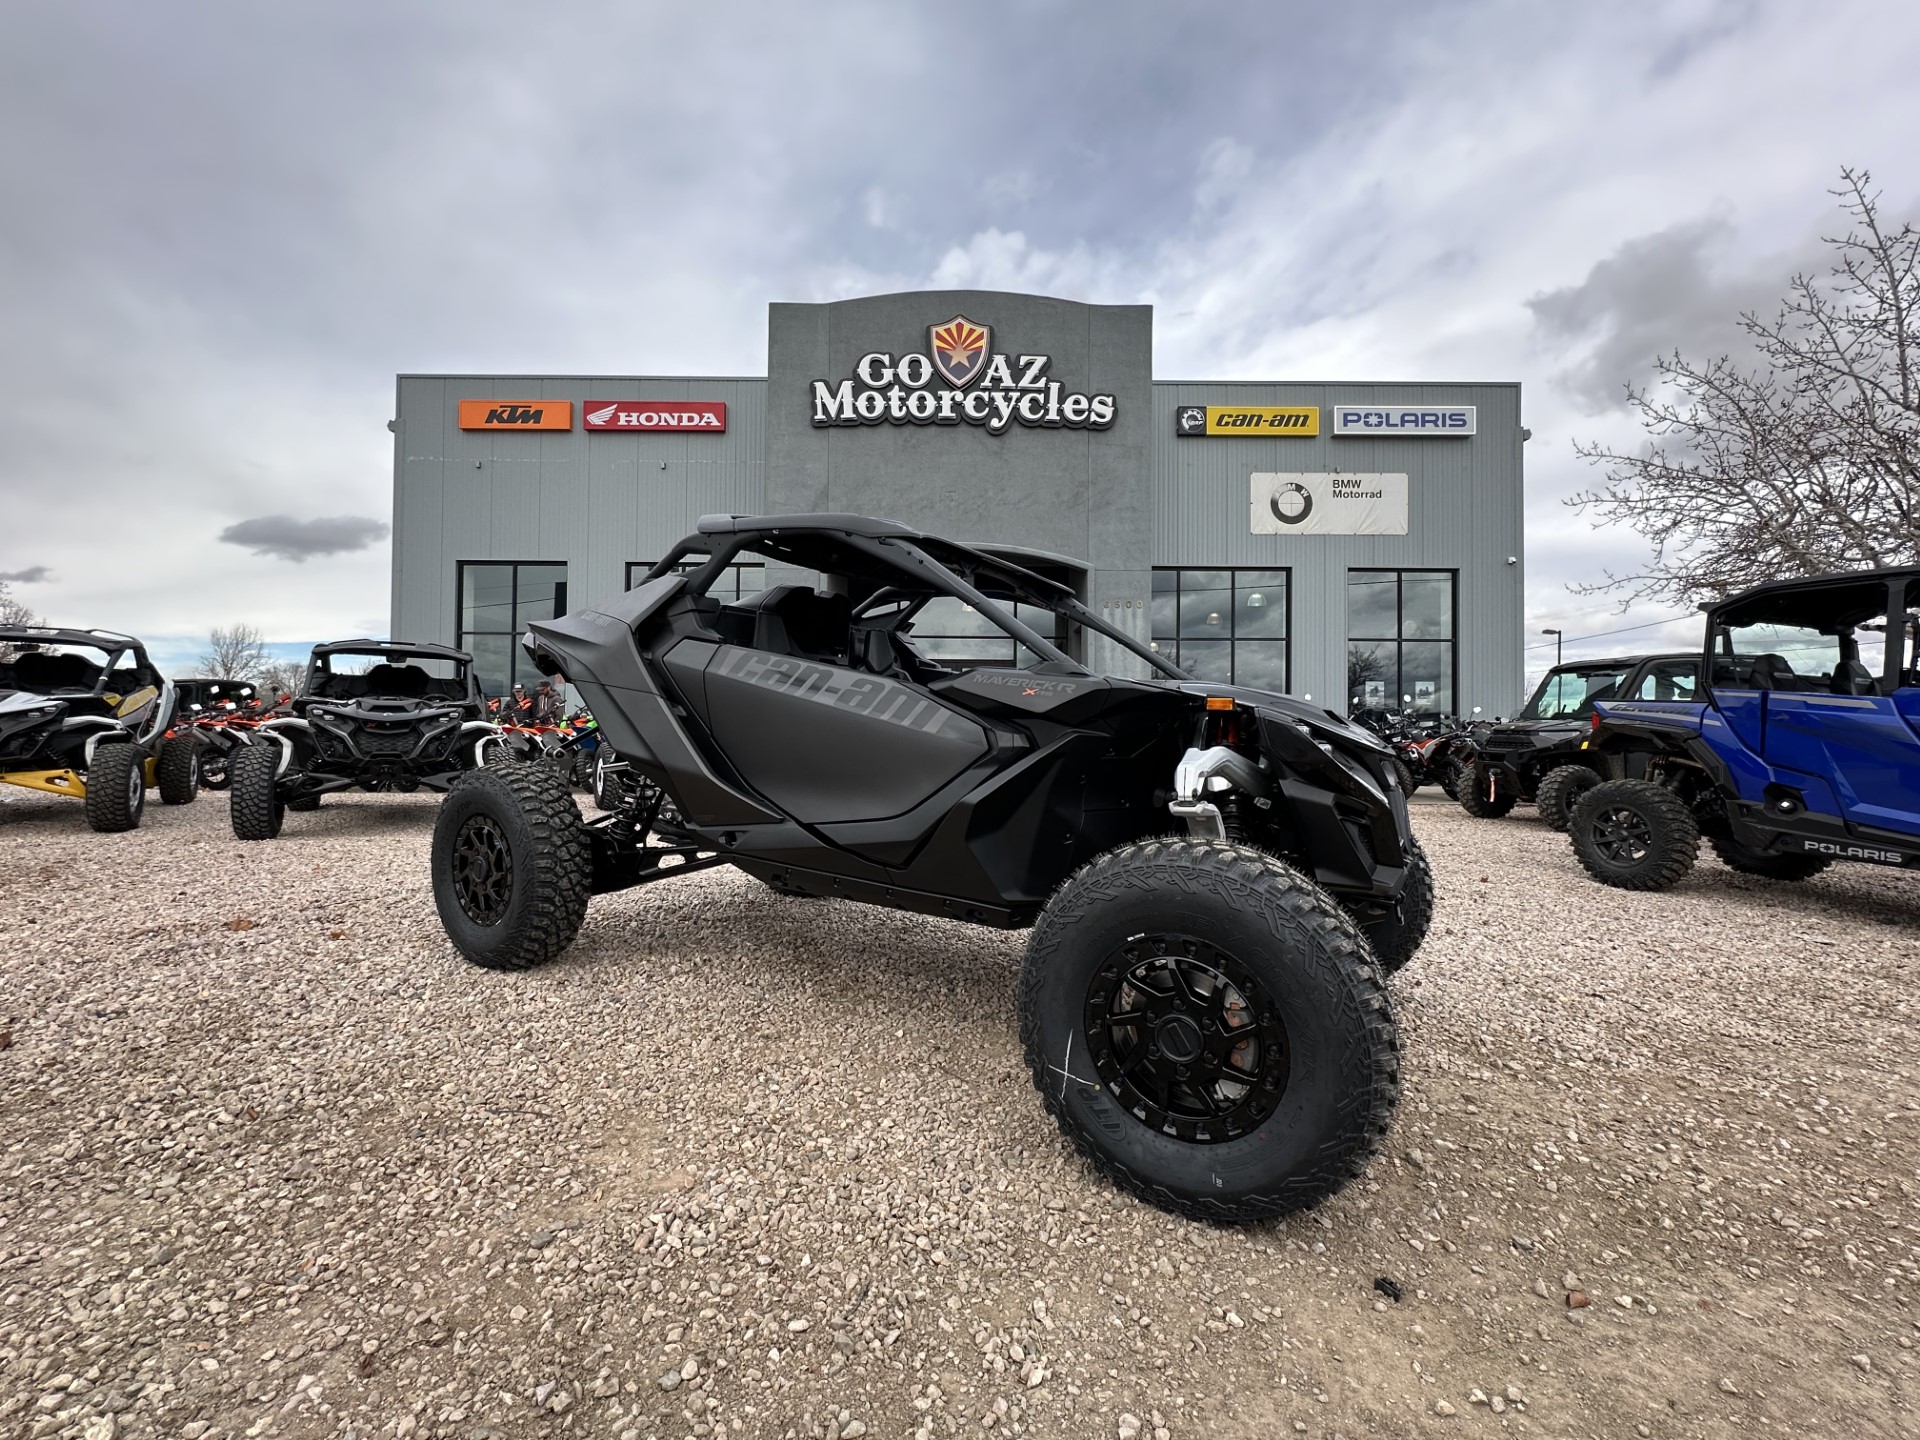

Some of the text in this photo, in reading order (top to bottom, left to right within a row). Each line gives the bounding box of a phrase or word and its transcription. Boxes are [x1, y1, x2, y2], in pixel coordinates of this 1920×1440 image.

[856, 352, 1049, 390] GO AZ
[813, 379, 1115, 429] Motorcycles
[485, 405, 543, 424] KTM
[617, 412, 721, 426] HONDA
[1215, 413, 1309, 428] can-am
[1342, 412, 1467, 428] POLARIS
[1332, 479, 1362, 489] BMW
[1332, 489, 1382, 499] Motorrad
[973, 674, 1059, 690] MAVERICK
[725, 650, 944, 732] can-am
[1804, 840, 1903, 863] POLARIS
[1076, 1087, 1121, 1132] ITP
